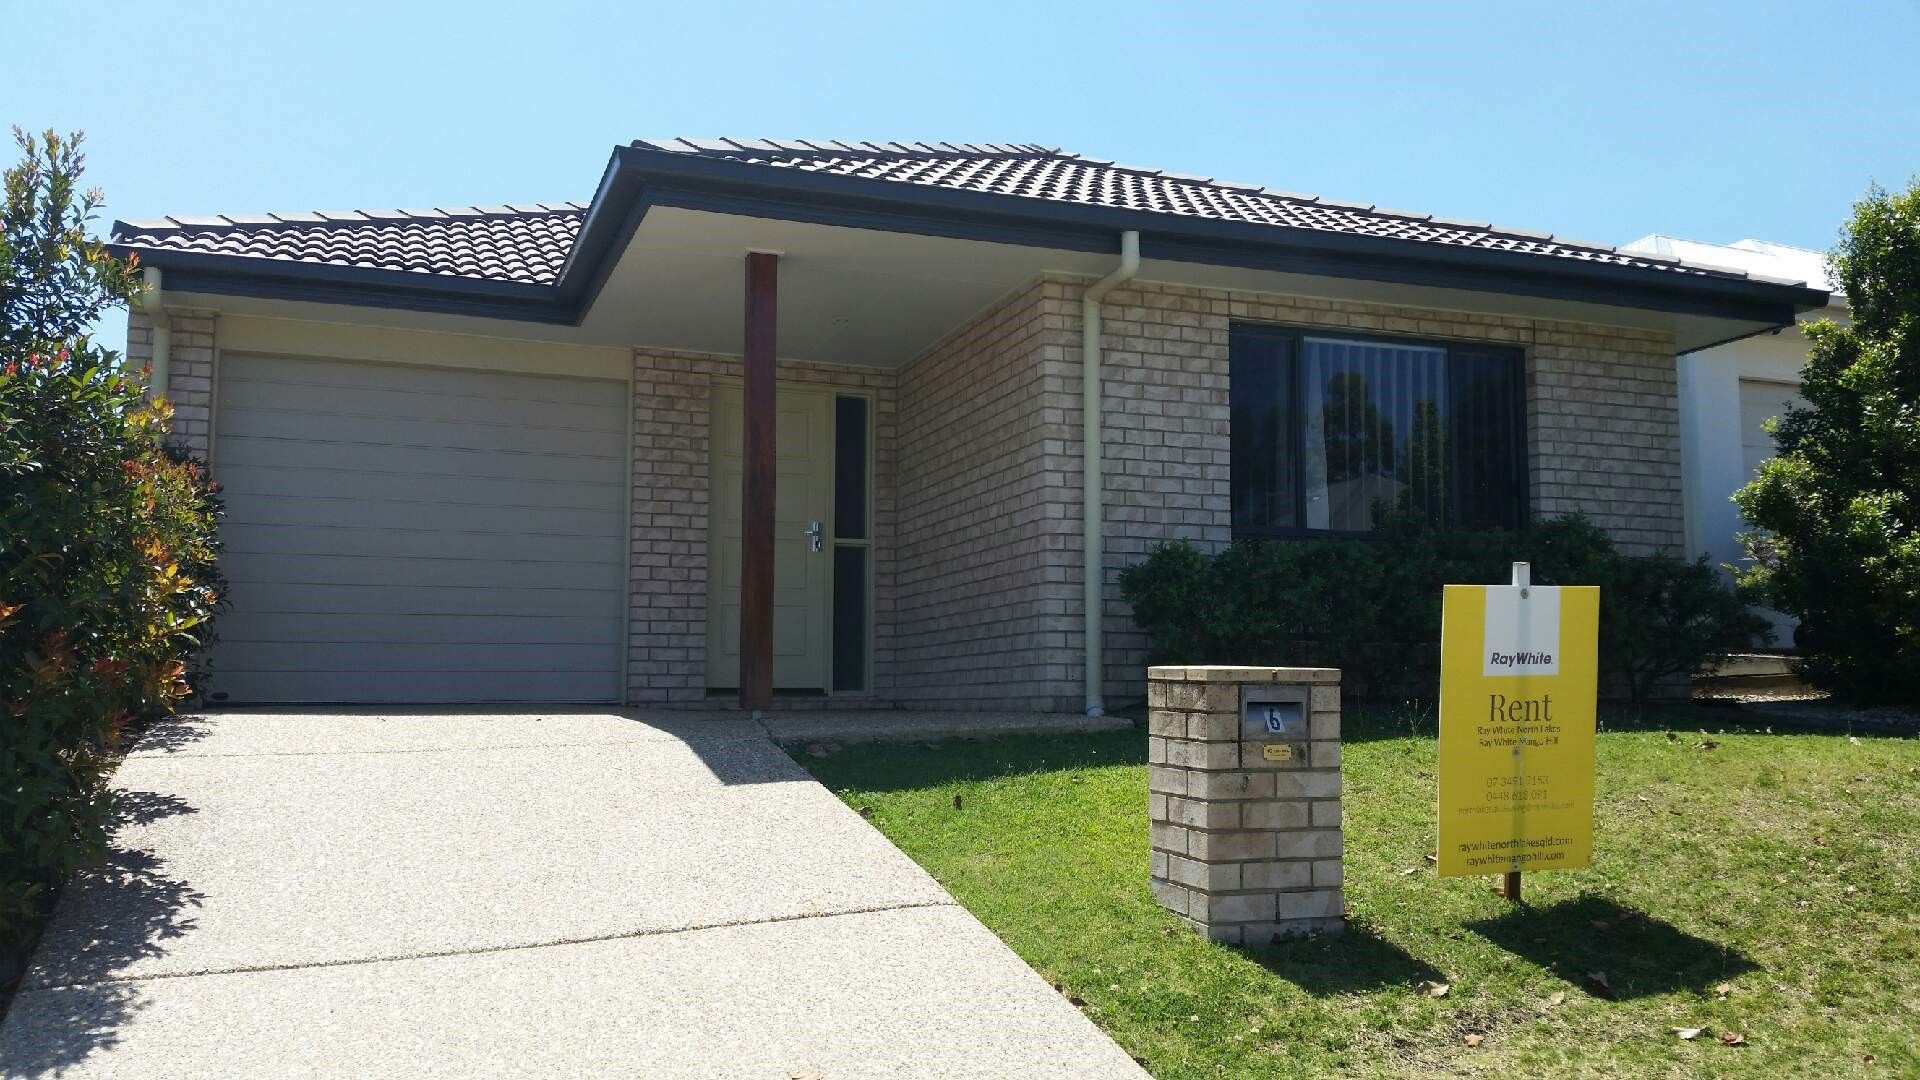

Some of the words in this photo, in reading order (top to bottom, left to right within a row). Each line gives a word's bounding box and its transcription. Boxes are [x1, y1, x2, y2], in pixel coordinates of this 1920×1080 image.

[1489, 694, 1553, 722] Rent
[1269, 708, 1281, 731] 6
[1477, 725, 1491, 736] Ray
[1492, 725, 1515, 735] White
[1494, 737, 1517, 746] White
